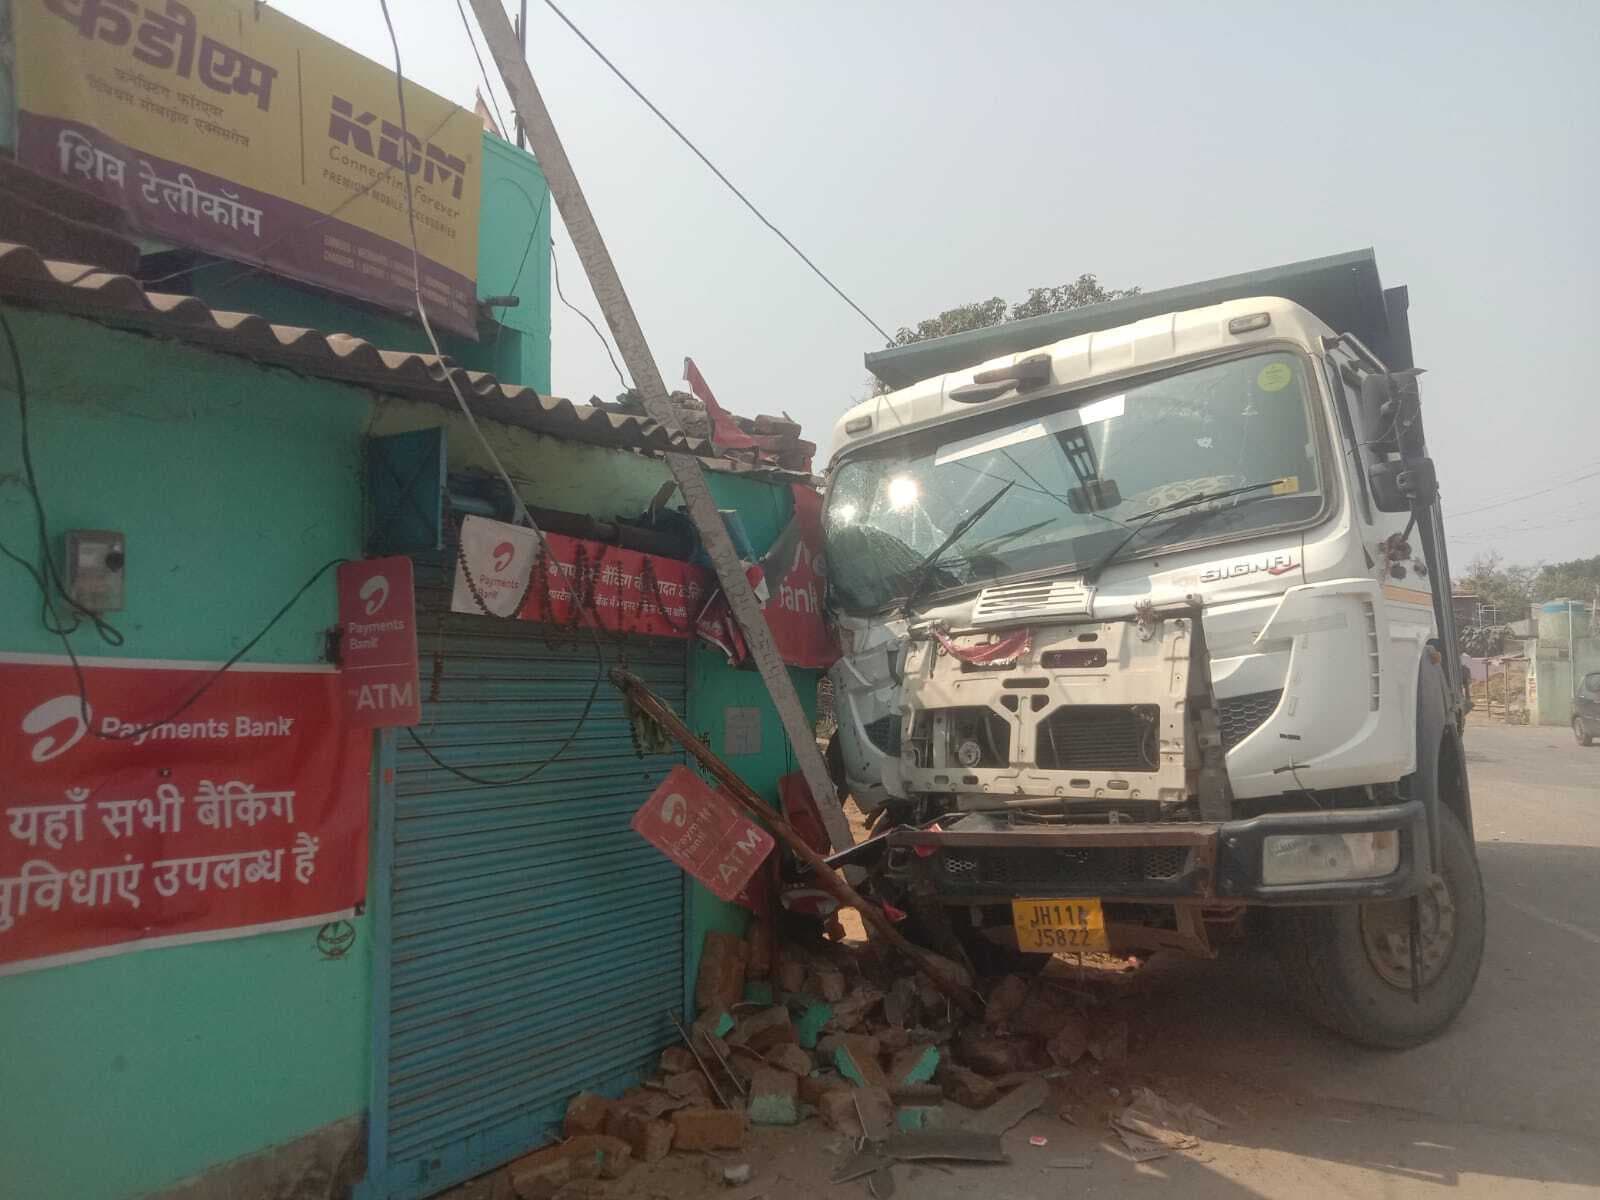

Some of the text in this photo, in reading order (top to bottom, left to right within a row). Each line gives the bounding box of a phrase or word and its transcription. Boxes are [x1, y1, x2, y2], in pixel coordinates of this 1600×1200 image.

[45, 0, 278, 112] कडीएम
[328, 94, 466, 200] KDM
[57, 130, 263, 237] शिव टेलीकॉम
[414, 185, 461, 219] Forever
[406, 206, 456, 239] CCESSORIES
[348, 619, 405, 637] Payments
[349, 636, 379, 650] Bank
[356, 681, 414, 711] ATM
[101, 716, 294, 745] Payments Bank
[6, 780, 296, 849] यहाँ सभी बैंकिंग
[152, 849, 285, 897] उपलब्ध
[292, 832, 320, 884] हैं
[718, 827, 762, 885] ATM
